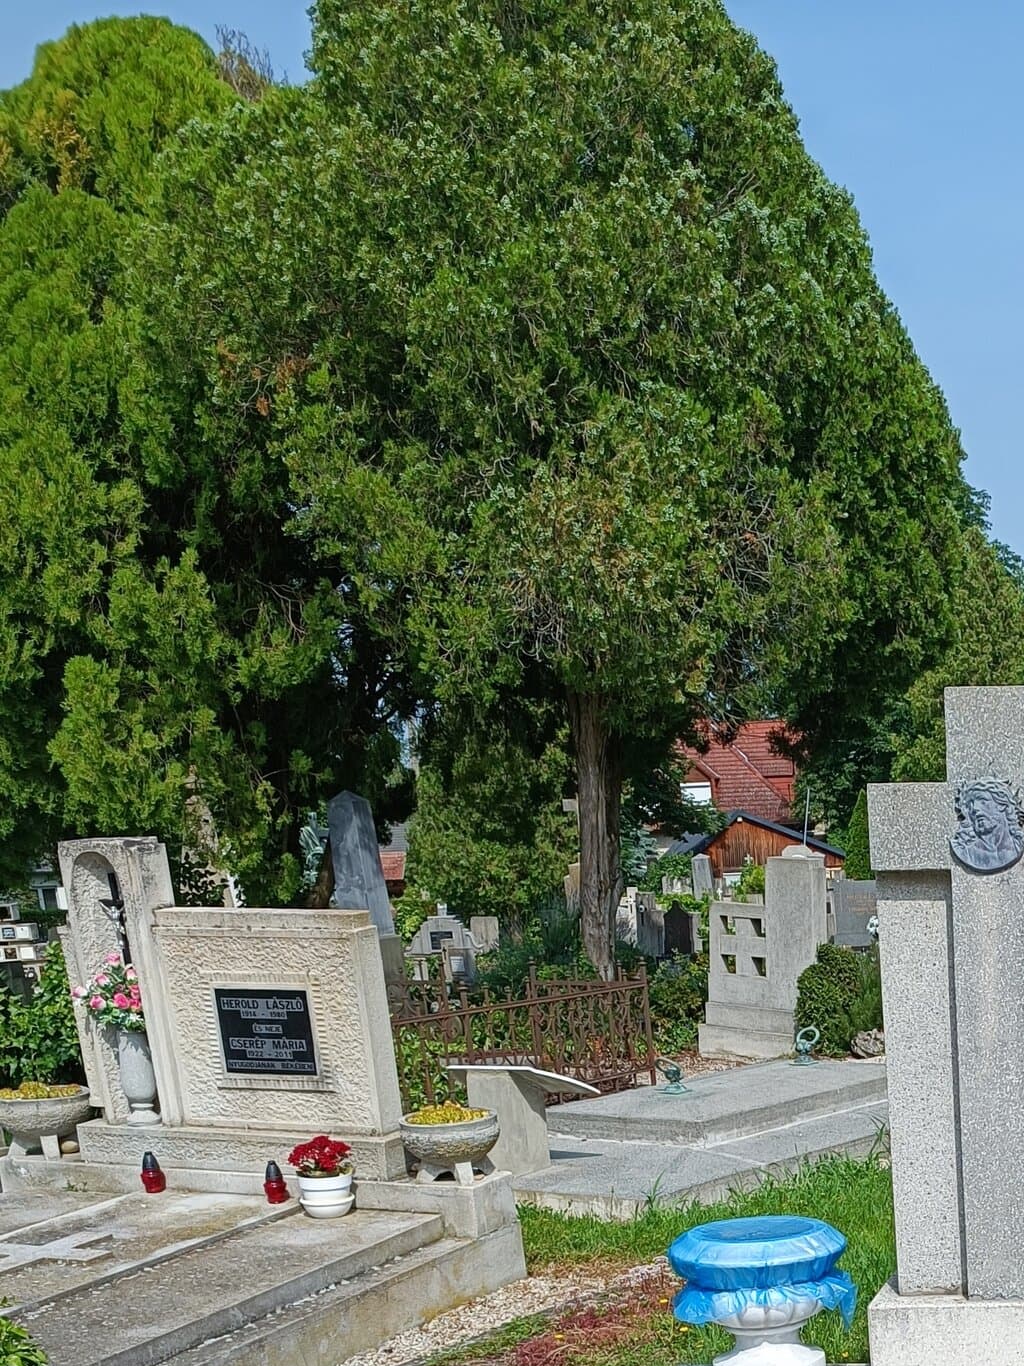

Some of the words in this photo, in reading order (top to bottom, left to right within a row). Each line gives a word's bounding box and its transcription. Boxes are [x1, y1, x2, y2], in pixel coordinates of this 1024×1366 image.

[222, 998, 259, 1009] HEROLD
[265, 997, 303, 1011] LÁSZLÓ
[231, 1037, 266, 1049] CSERÉP
[272, 1037, 306, 1051] MÁRIA
[274, 1051, 293, 1059] 2011
